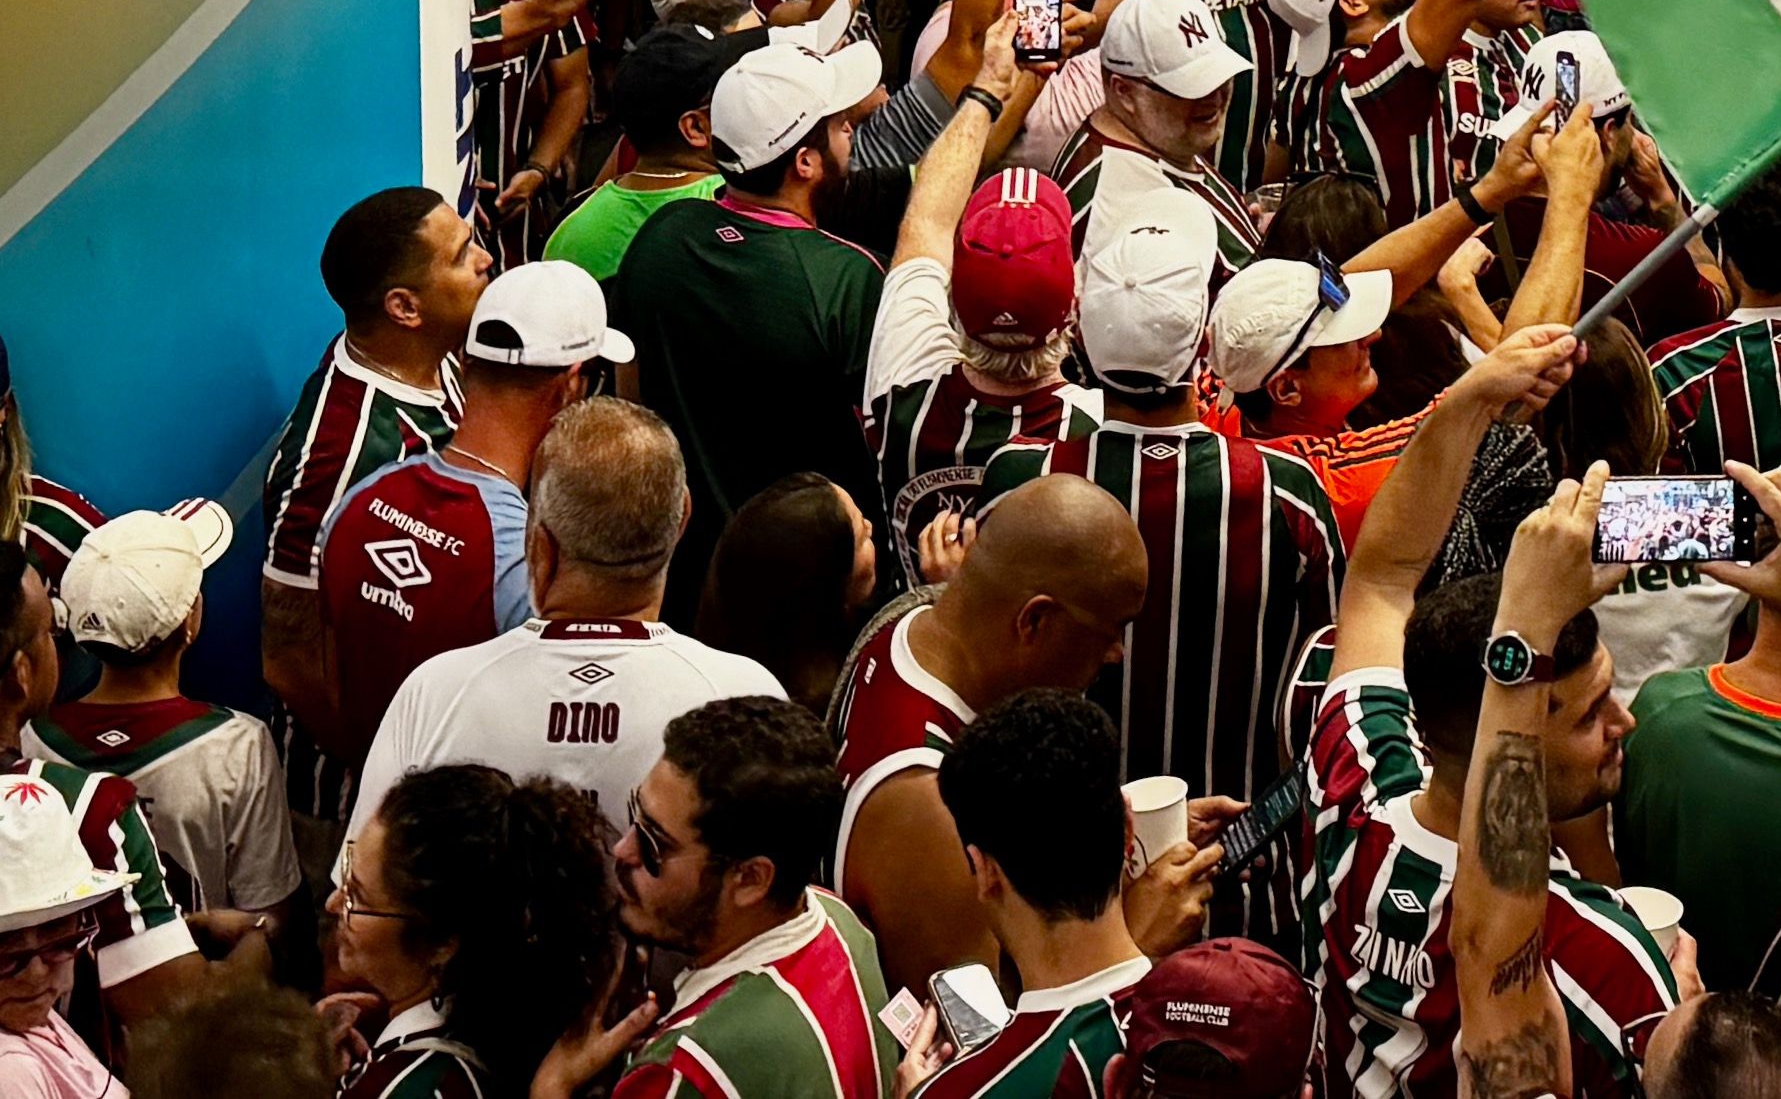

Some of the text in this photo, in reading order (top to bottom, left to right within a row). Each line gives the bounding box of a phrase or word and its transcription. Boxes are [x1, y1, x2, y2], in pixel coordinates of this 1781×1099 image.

[1522, 63, 1545, 101] NY
[443, 536, 466, 556] FC
[361, 581, 415, 622] umbro
[547, 701, 621, 744] DINO
